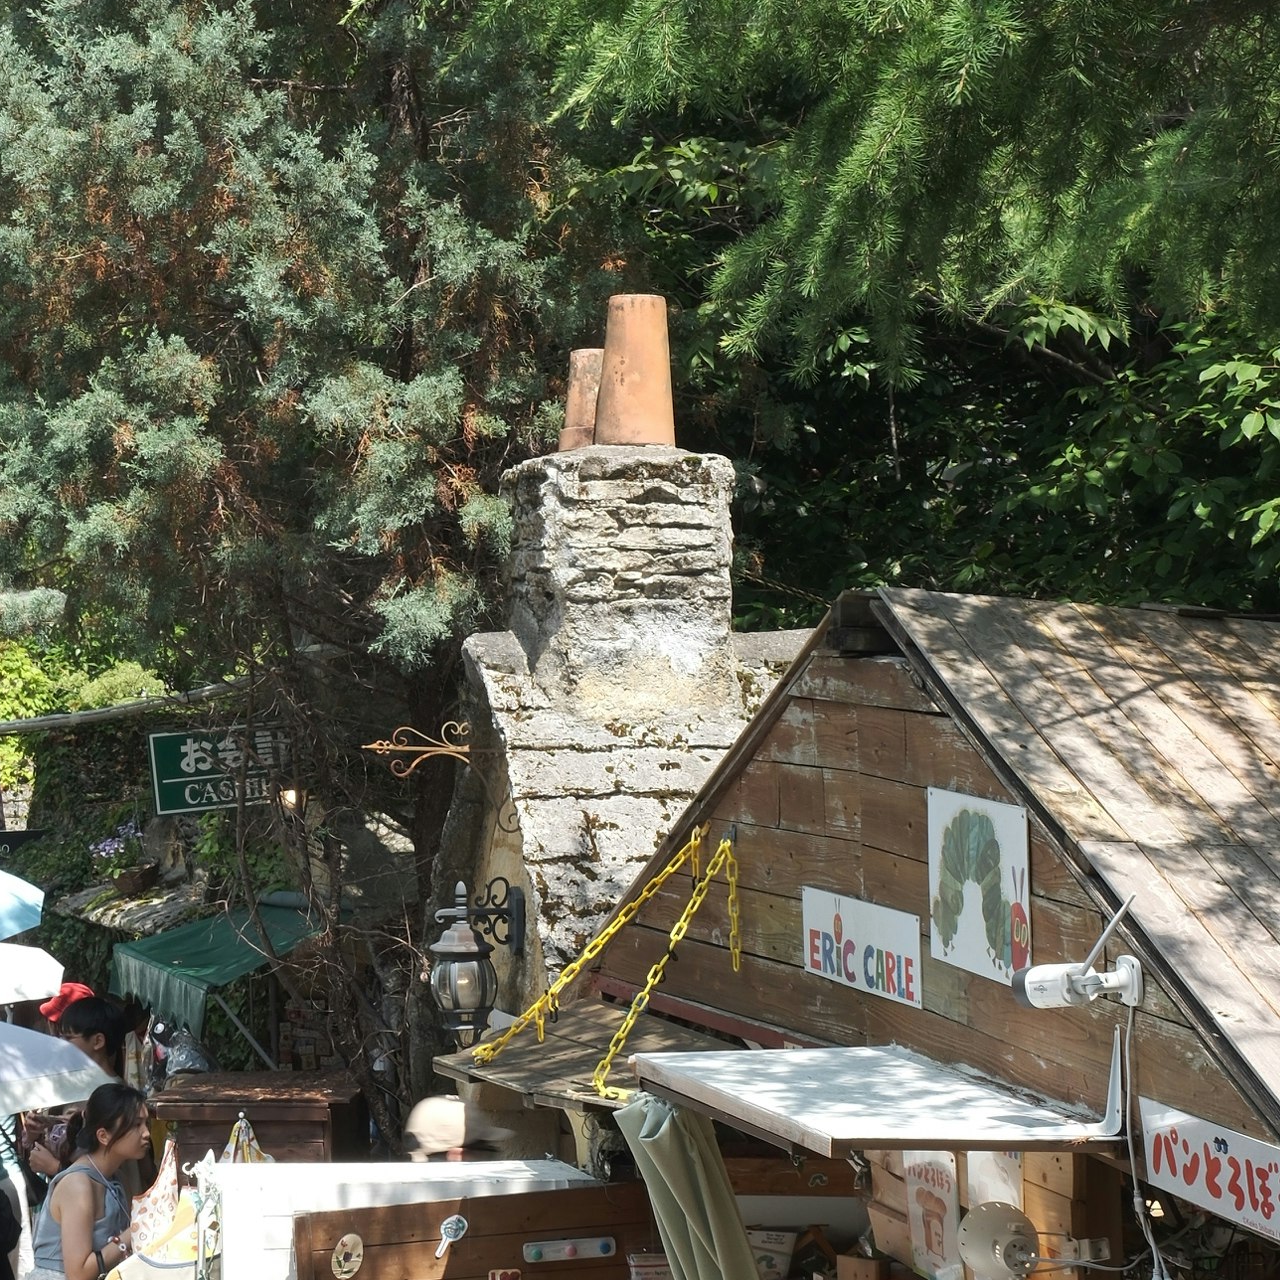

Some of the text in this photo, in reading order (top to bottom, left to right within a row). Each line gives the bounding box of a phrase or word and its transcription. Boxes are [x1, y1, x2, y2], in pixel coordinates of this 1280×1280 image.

[863, 944, 914, 1002] CARLE
[1153, 1126, 1280, 1220] パンどろぼ
